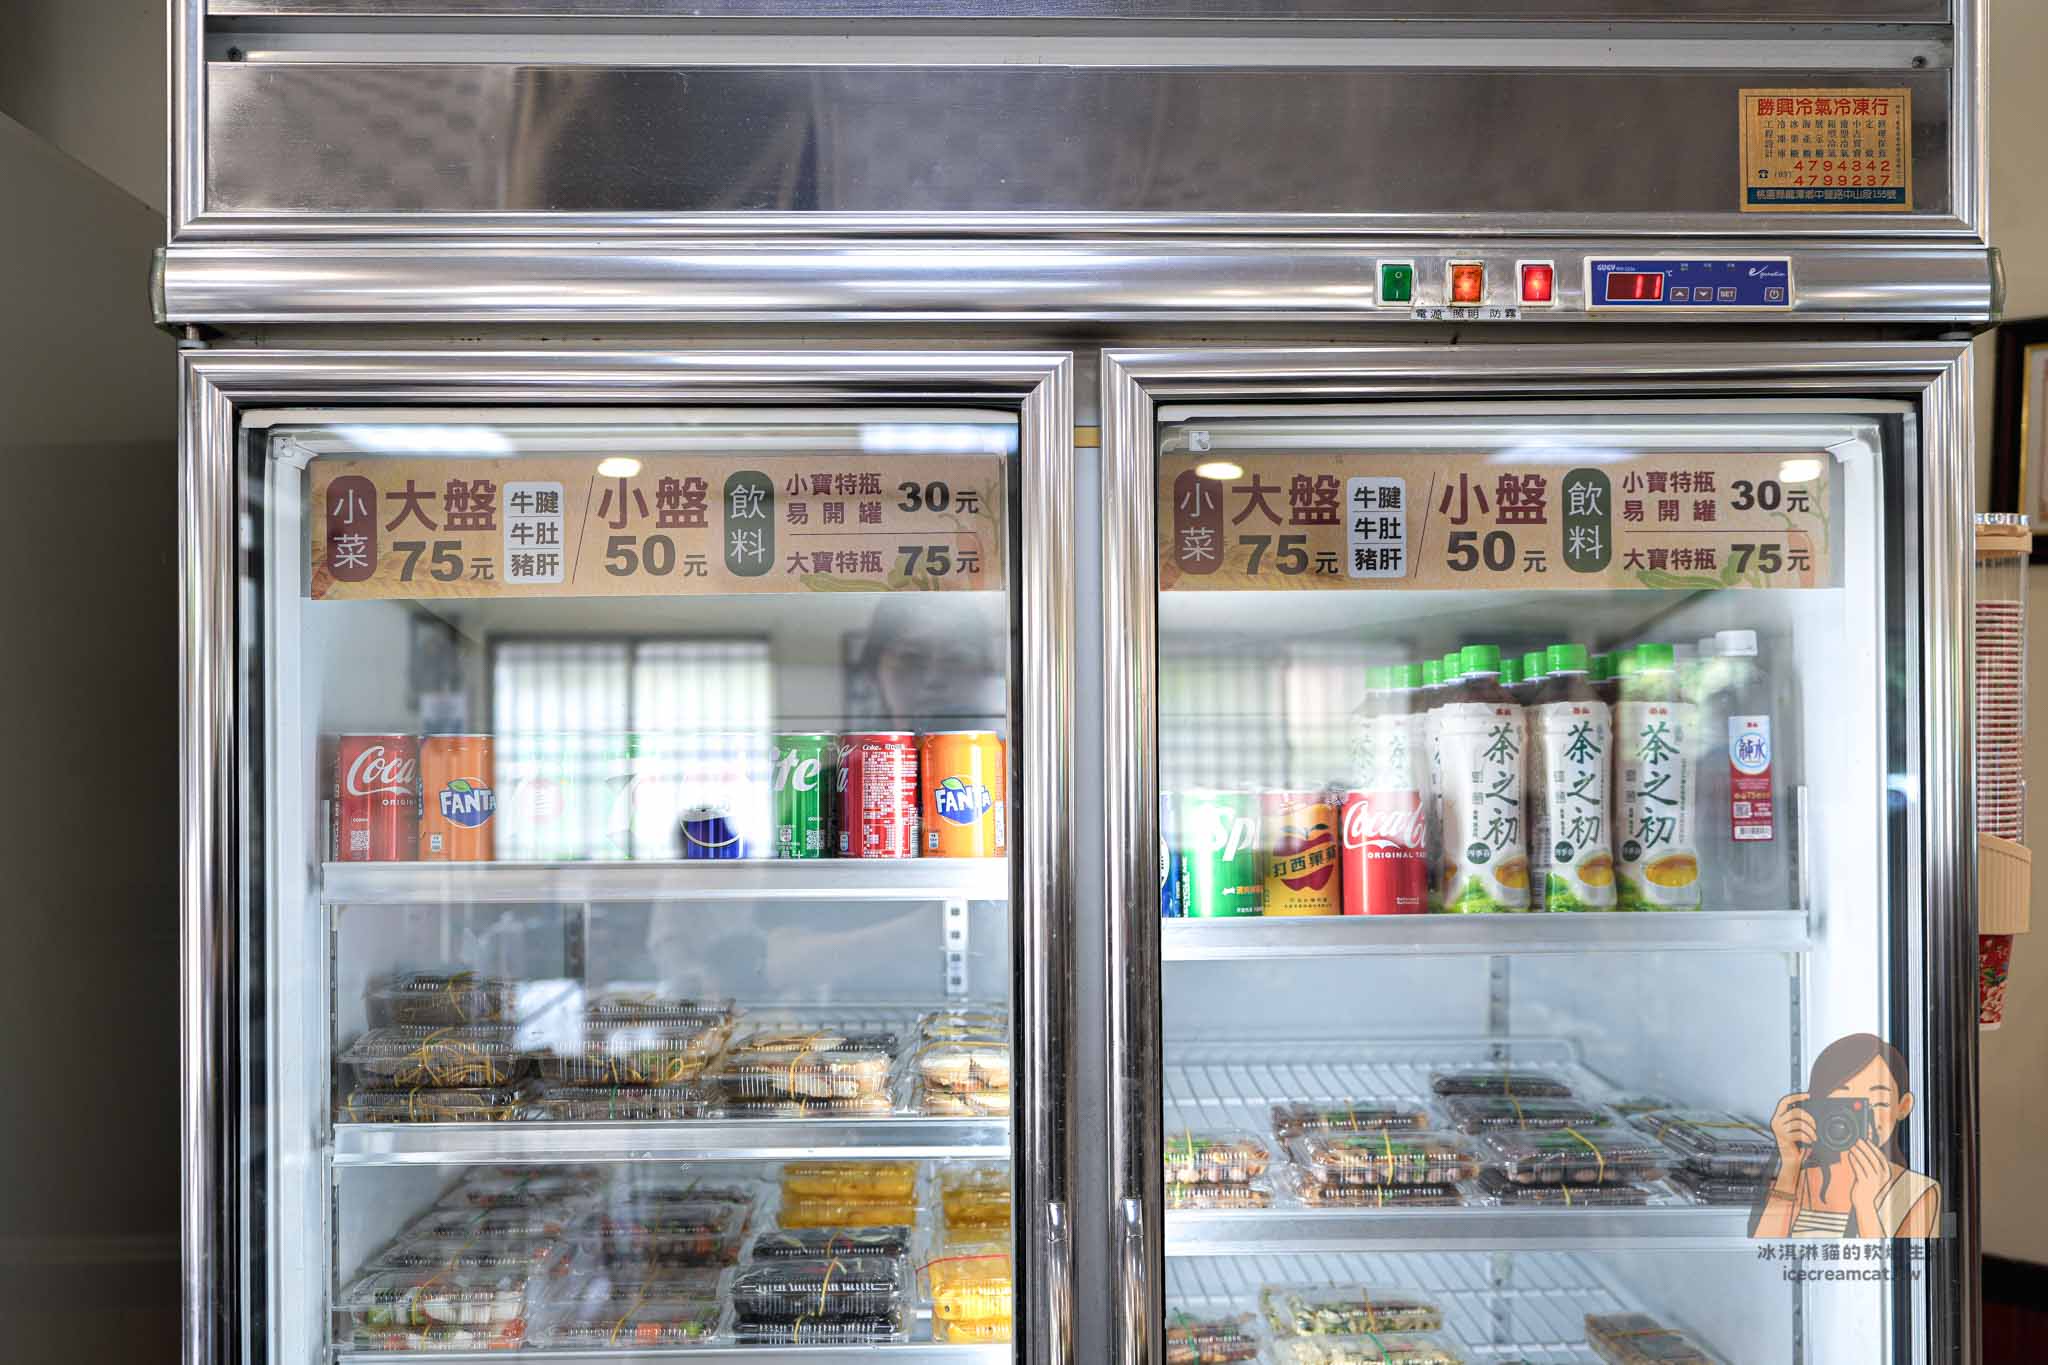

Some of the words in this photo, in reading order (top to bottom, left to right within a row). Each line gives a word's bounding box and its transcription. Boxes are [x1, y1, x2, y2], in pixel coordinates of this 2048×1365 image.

[1757, 98, 1889, 117] 勝興冷氣冷凍行
[1794, 160, 1892, 172] 4794342
[1794, 175, 1891, 186] 4799237
[1634, 274, 1662, 299] 11
[1416, 309, 1442, 320] 電源
[1453, 309, 1479, 319] 照明
[786, 473, 882, 496] 小寶特瓶
[1622, 471, 1715, 494] 小寶特瓶
[1731, 480, 1809, 513] 30元
[385, 479, 497, 532] 大盤
[511, 491, 559, 515] 牛腱
[598, 476, 708, 530] 小盤
[897, 481, 979, 514] 30元
[1231, 473, 1341, 526] 大盤
[1354, 486, 1401, 509] 牛腱
[1439, 473, 1547, 525] 小盤
[1623, 500, 1716, 522] 易開罐
[729, 483, 766, 564] 飲料
[786, 502, 882, 525] 易開罐
[1180, 482, 1215, 561] 小菜
[1568, 481, 1603, 560] 飲料
[333, 490, 369, 568] 小菜
[511, 522, 559, 545] 牛肚
[1354, 517, 1401, 540] 牛肚
[391, 540, 494, 582] 75元
[511, 554, 559, 577] 豬肝
[604, 535, 708, 577] 50元
[786, 551, 883, 574] 大寶特瓶
[898, 545, 980, 576] 75元
[1238, 534, 1338, 575] 75元
[1354, 548, 1401, 571] 豬肝
[1446, 531, 1547, 573] 50元
[1623, 548, 1716, 571] 大寶特瓶
[1730, 544, 1810, 573] 75元
[934, 785, 992, 814] FANTA
[1482, 723, 1520, 849] 茶之初
[1563, 723, 1601, 849] 茶之初
[1635, 723, 1680, 849] 茶之初
